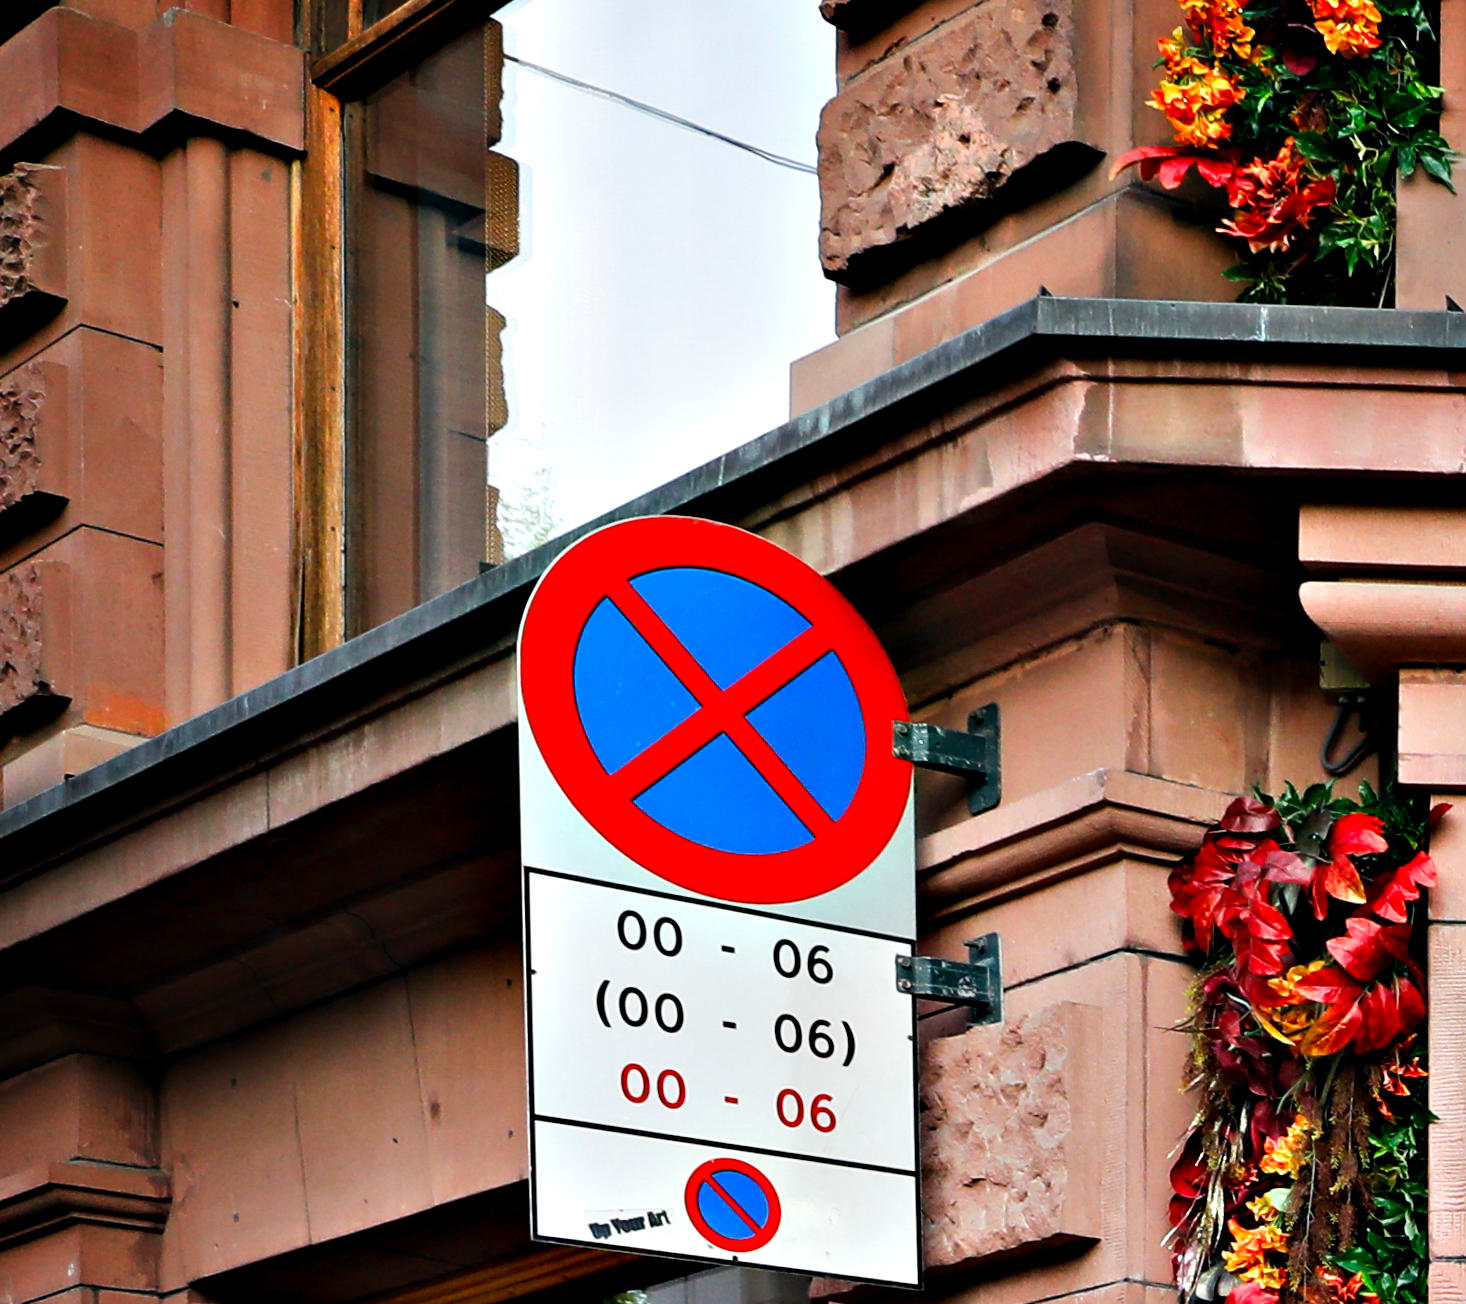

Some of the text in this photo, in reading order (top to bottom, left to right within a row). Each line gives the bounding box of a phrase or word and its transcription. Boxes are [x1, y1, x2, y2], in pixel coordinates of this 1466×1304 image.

[617, 909, 683, 957] 00
[773, 939, 834, 984] 06
[596, 979, 684, 1034] (00
[774, 1013, 856, 1067] 06)
[620, 1063, 686, 1109] 00
[776, 1088, 837, 1133] 06
[610, 1216, 645, 1234] Your
[647, 1210, 671, 1228] Art
